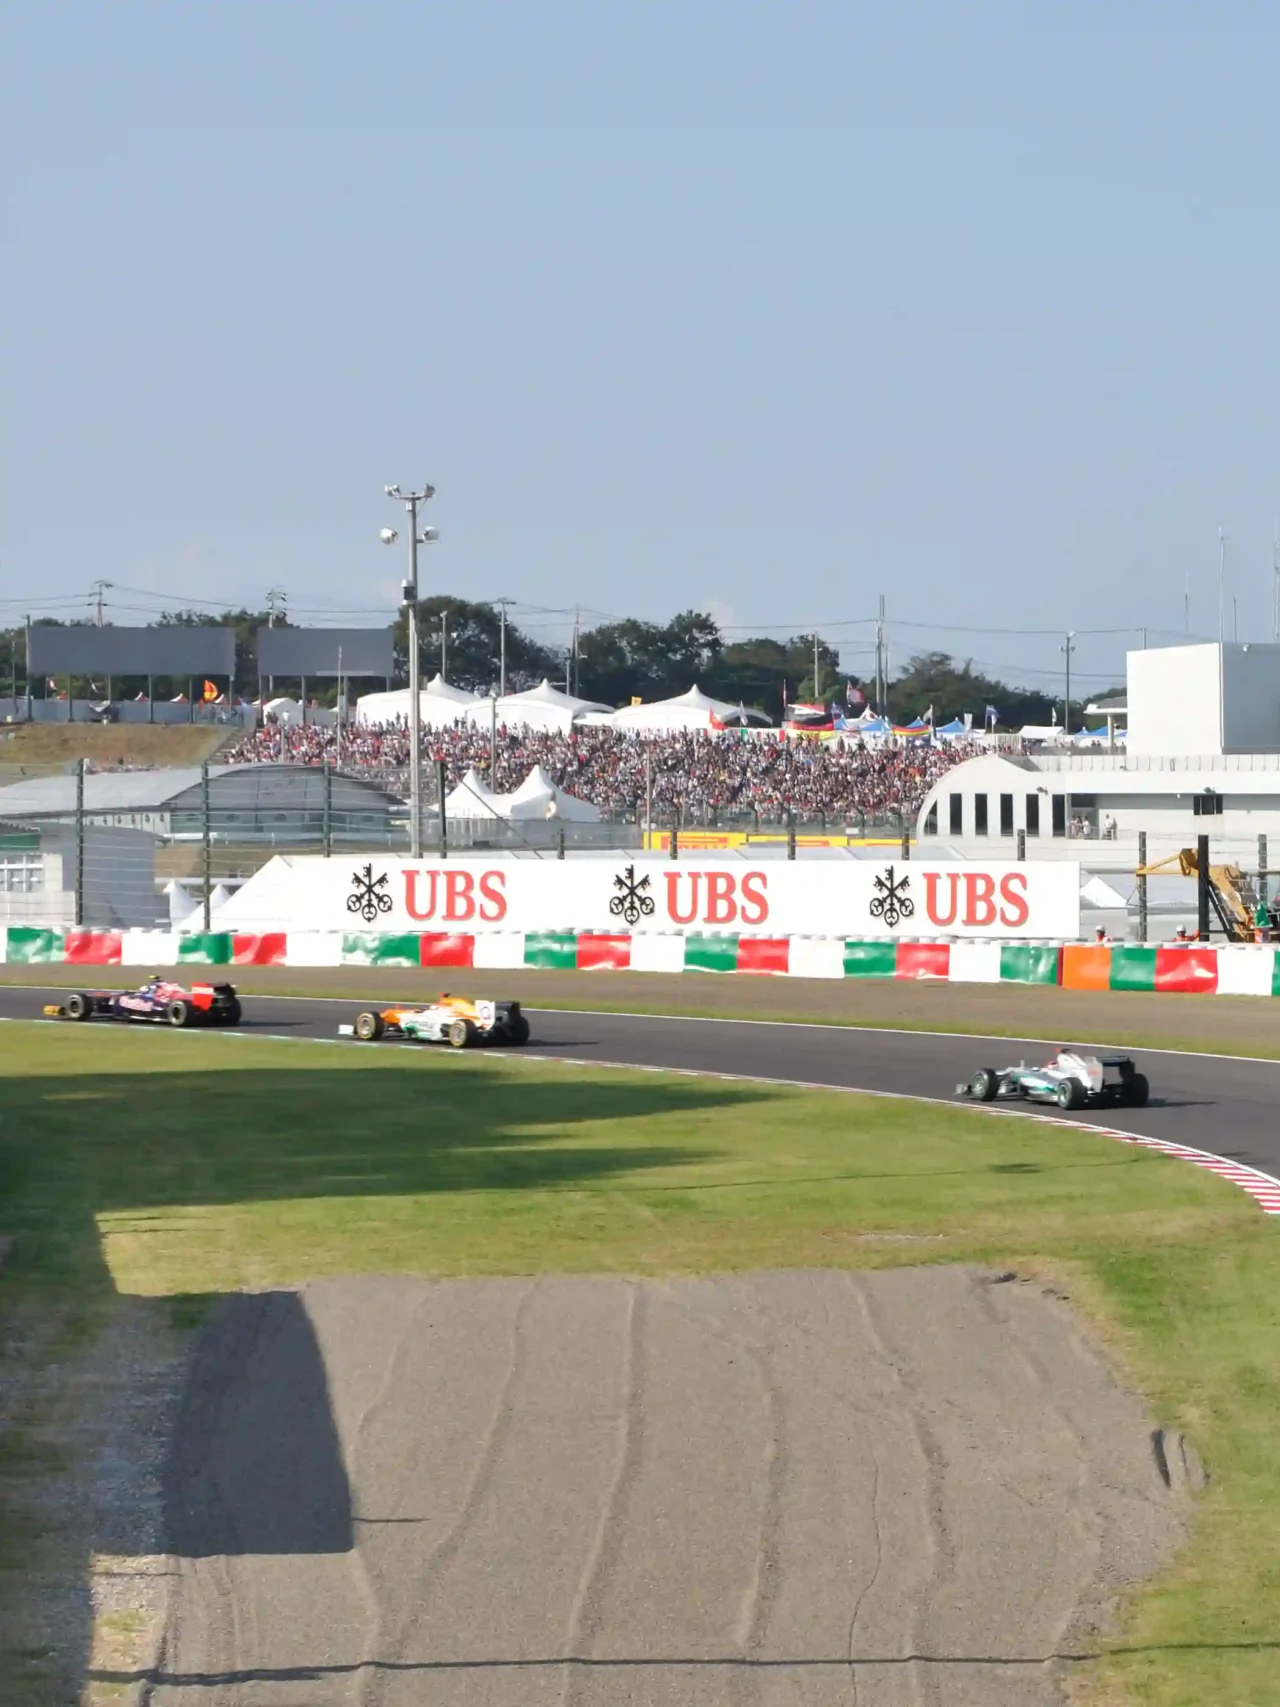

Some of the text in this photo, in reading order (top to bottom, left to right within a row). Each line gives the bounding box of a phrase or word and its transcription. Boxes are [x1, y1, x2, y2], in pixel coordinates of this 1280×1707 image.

[402, 870, 507, 922] UBS
[664, 872, 769, 925] UBS
[923, 872, 1029, 927] UBS
